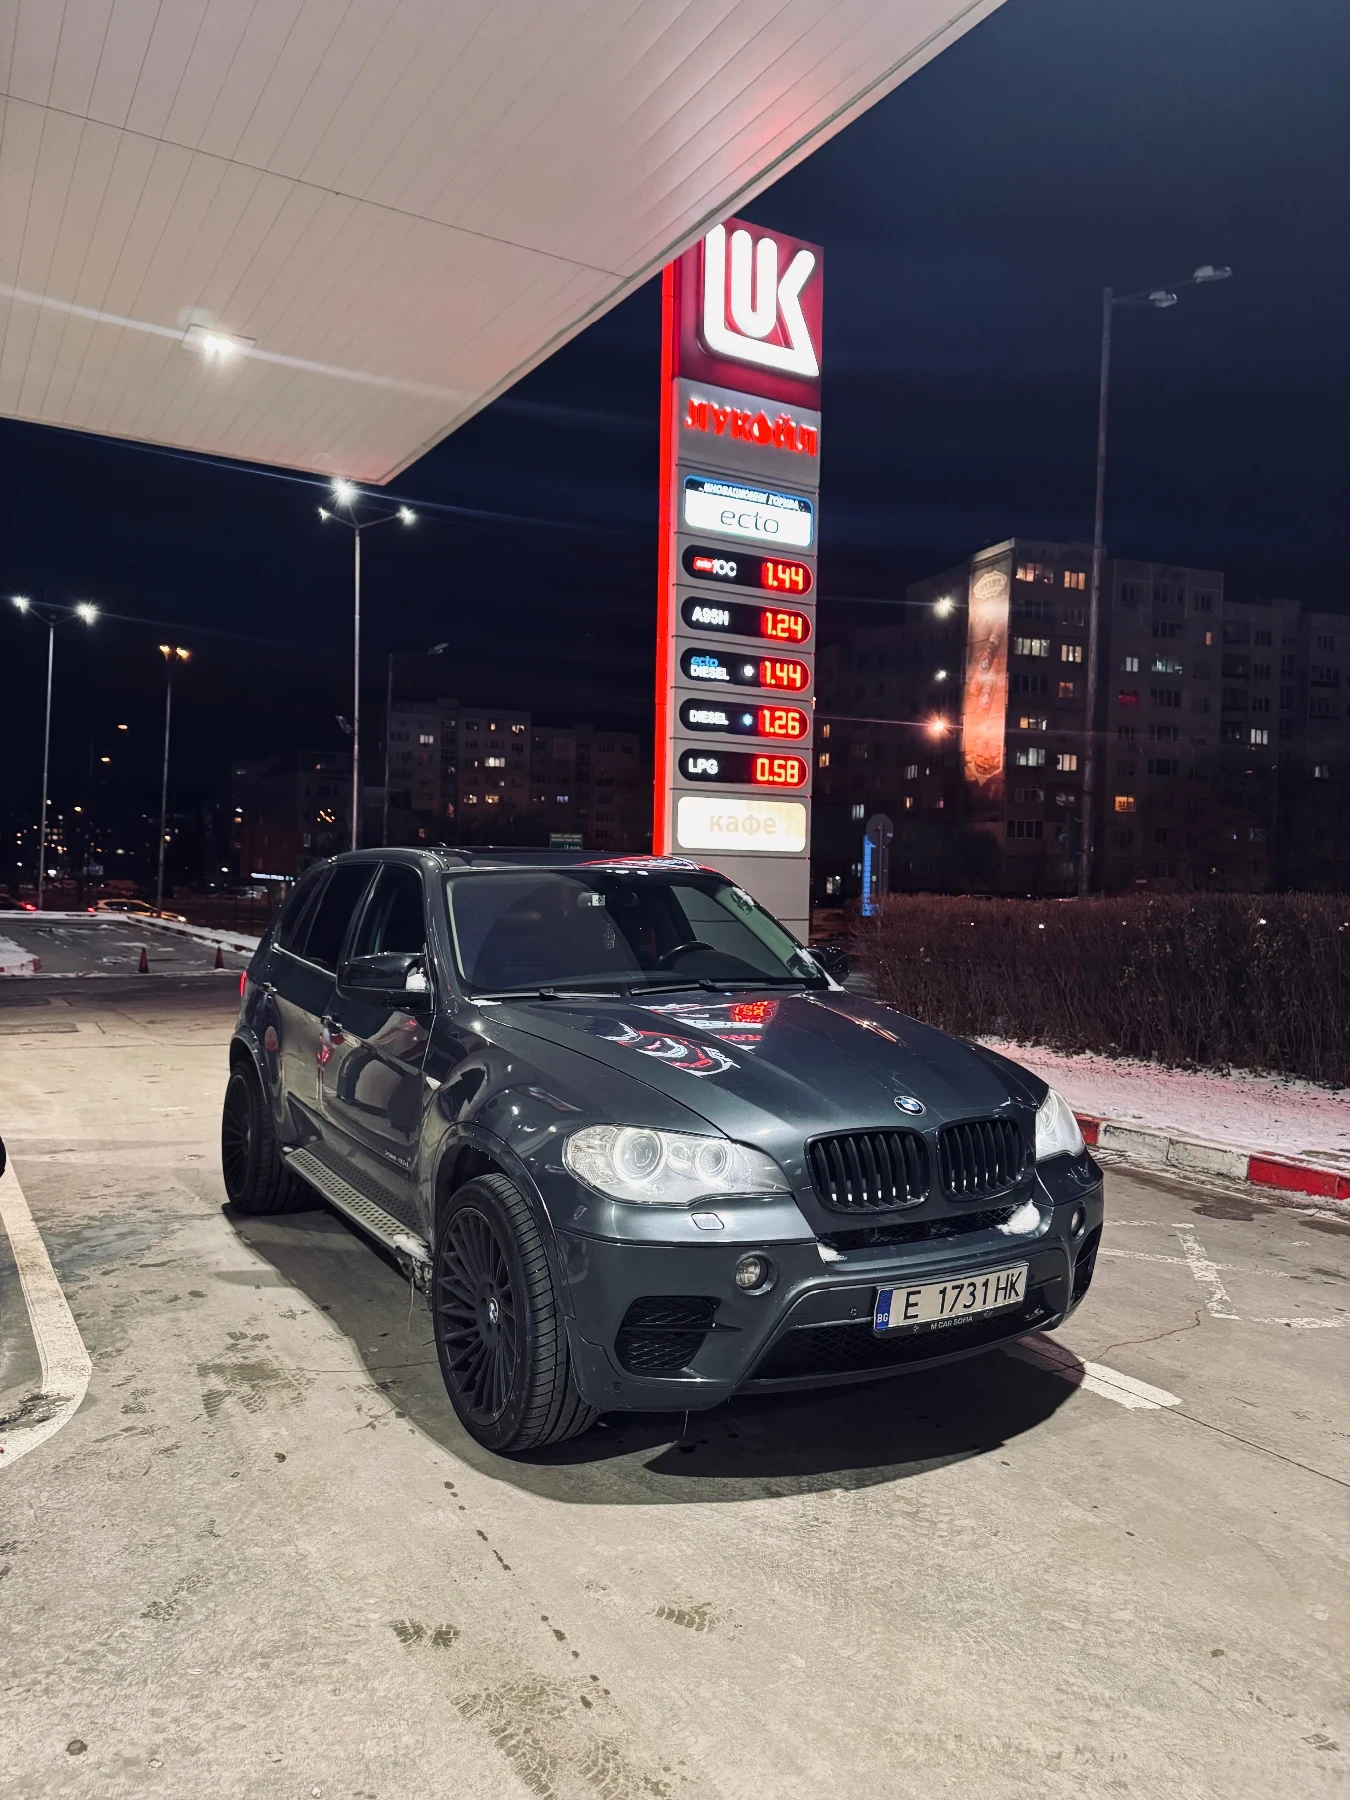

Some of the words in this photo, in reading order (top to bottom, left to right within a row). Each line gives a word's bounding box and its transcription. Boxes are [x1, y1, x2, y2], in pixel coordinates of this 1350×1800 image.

[685, 398, 817, 456] ЛУКОЙЛ
[720, 510, 779, 534] ecto
[767, 562, 803, 590] 1.44
[766, 612, 802, 639] 1.24
[690, 665, 730, 680] DIESEL
[691, 656, 718, 667] ecto
[765, 661, 801, 688] 1.44
[689, 710, 729, 726] DIESEL
[763, 709, 800, 735] 1.26
[688, 757, 719, 775] LPG
[756, 758, 799, 783] 0.58
[709, 814, 777, 836] кафе
[903, 1290, 921, 1320] E
[877, 1313, 889, 1323] BG
[953, 1314, 973, 1326] SOFIA
